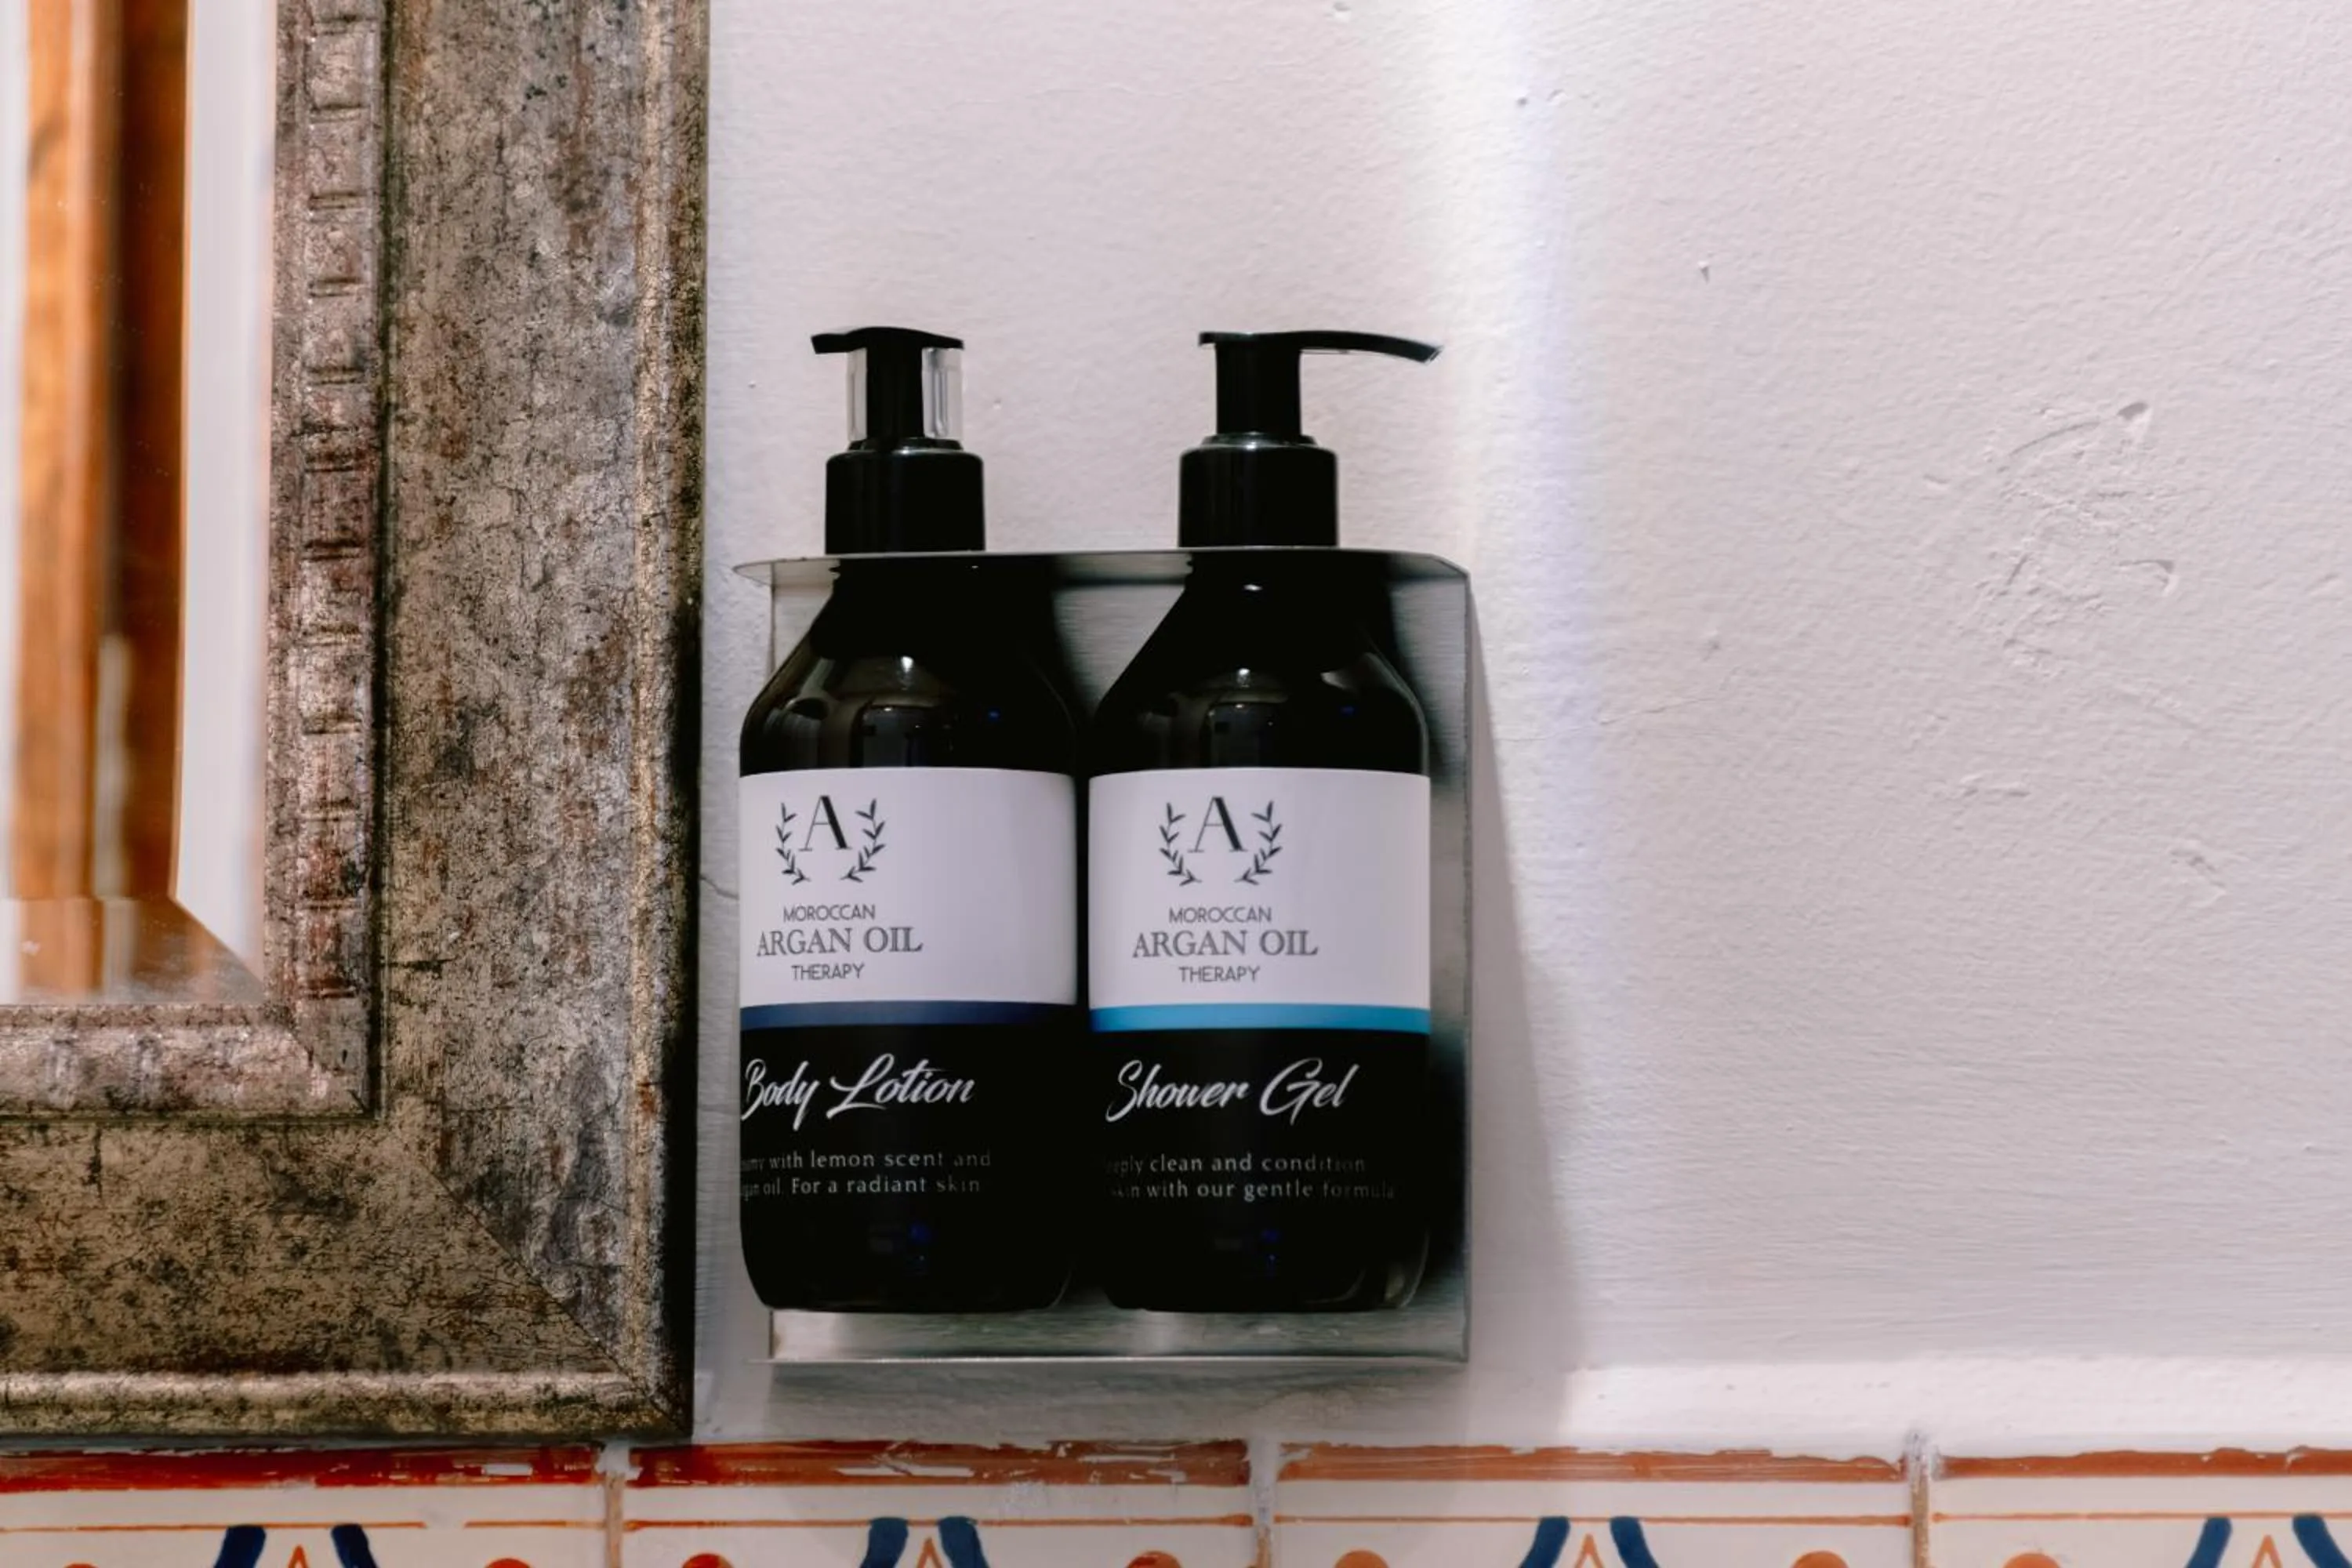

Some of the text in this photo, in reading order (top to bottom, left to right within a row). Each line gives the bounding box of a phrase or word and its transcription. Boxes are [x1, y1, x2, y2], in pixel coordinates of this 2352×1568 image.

[798, 795, 851, 851] A
[1188, 796, 1249, 853] A
[783, 904, 876, 923] MOROCCAN
[1169, 906, 1272, 924] MOROCCAN
[757, 927, 924, 956] ARGAN OIL
[1133, 930, 1319, 958] ARGAN OIL
[792, 964, 864, 981] THERAPY
[1179, 966, 1260, 982] THERAPY
[741, 1053, 976, 1131] Body Lotion
[1105, 1058, 1359, 1125] Shower Gel
[769, 1149, 803, 1170] with
[811, 1149, 874, 1168] lemon
[884, 1151, 943, 1167] scent
[953, 1147, 991, 1167] and
[1149, 1152, 1203, 1173] clean
[1210, 1152, 1253, 1172] and
[1261, 1152, 1366, 1173] condition
[791, 1177, 821, 1195] For
[828, 1180, 837, 1195] a
[847, 1174, 926, 1193] radiant
[936, 1174, 980, 1193] skin
[1146, 1178, 1189, 1199] with
[1196, 1182, 1237, 1198] our
[1243, 1177, 1313, 1203] gentle
